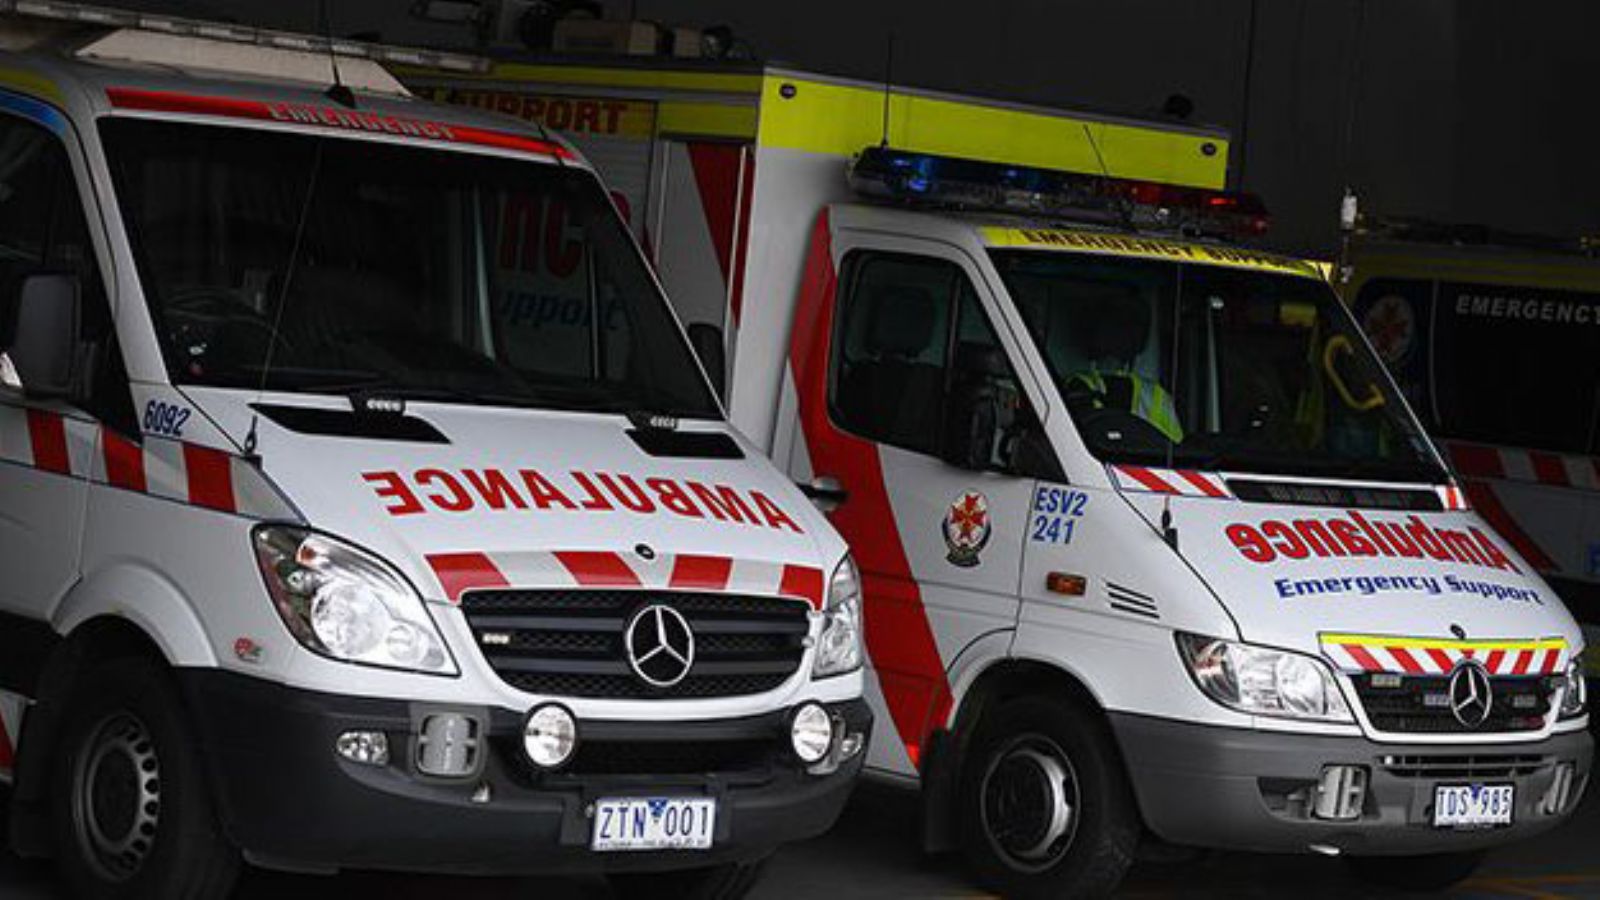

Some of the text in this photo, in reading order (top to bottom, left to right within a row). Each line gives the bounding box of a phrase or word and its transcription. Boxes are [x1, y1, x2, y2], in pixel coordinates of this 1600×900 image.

[267, 102, 455, 140] EMERGENCY
[1023, 229, 1193, 258] EMERGENCY
[143, 400, 191, 436] 6092
[1034, 487, 1089, 517] ESV2
[1032, 516, 1075, 544] 241
[1274, 573, 1545, 606] Emergency Support
[1480, 788, 1510, 816] 985
[600, 804, 708, 838] ZTN 001
